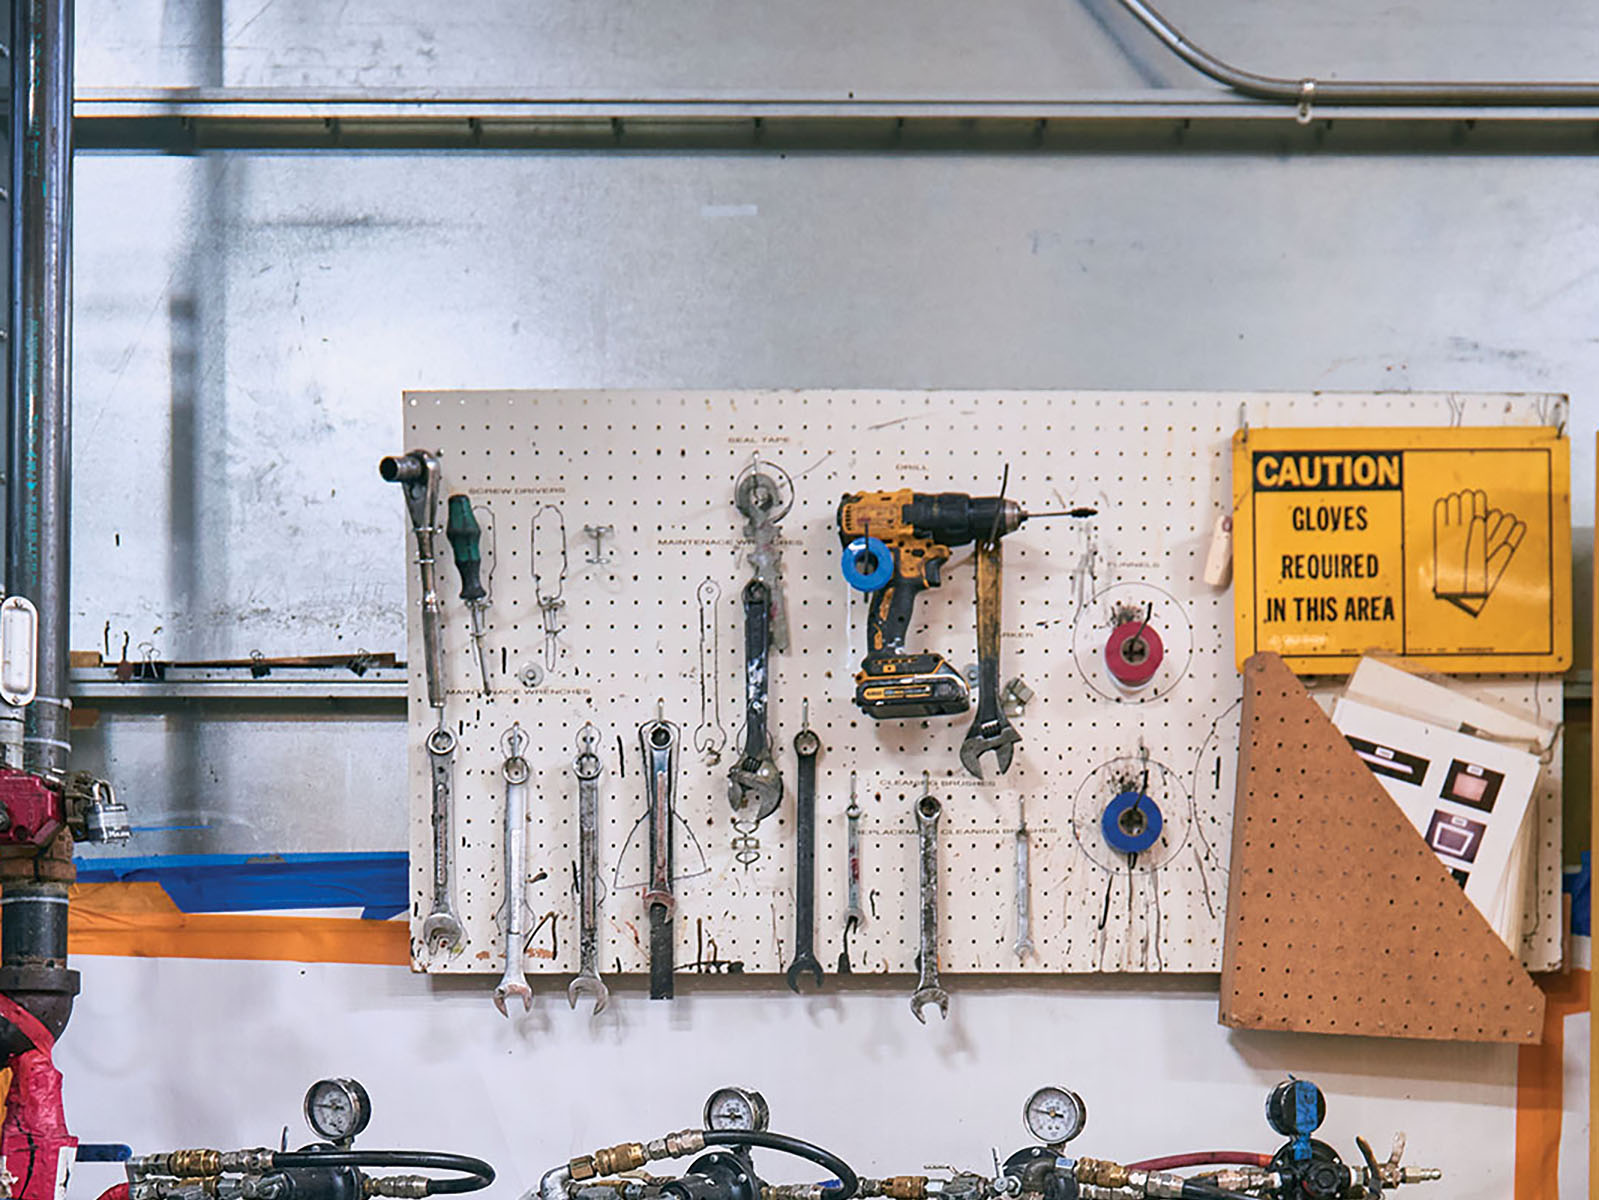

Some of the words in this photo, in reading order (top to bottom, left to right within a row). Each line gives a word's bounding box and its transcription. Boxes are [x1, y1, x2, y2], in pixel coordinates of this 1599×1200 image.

[1255, 455, 1400, 487] CAUTION
[1292, 506, 1368, 531] GLOVES
[1281, 554, 1379, 579] REQUIRED
[1267, 597, 1285, 622] IN
[1293, 597, 1338, 622] THIS
[1344, 596, 1395, 622] AREA
